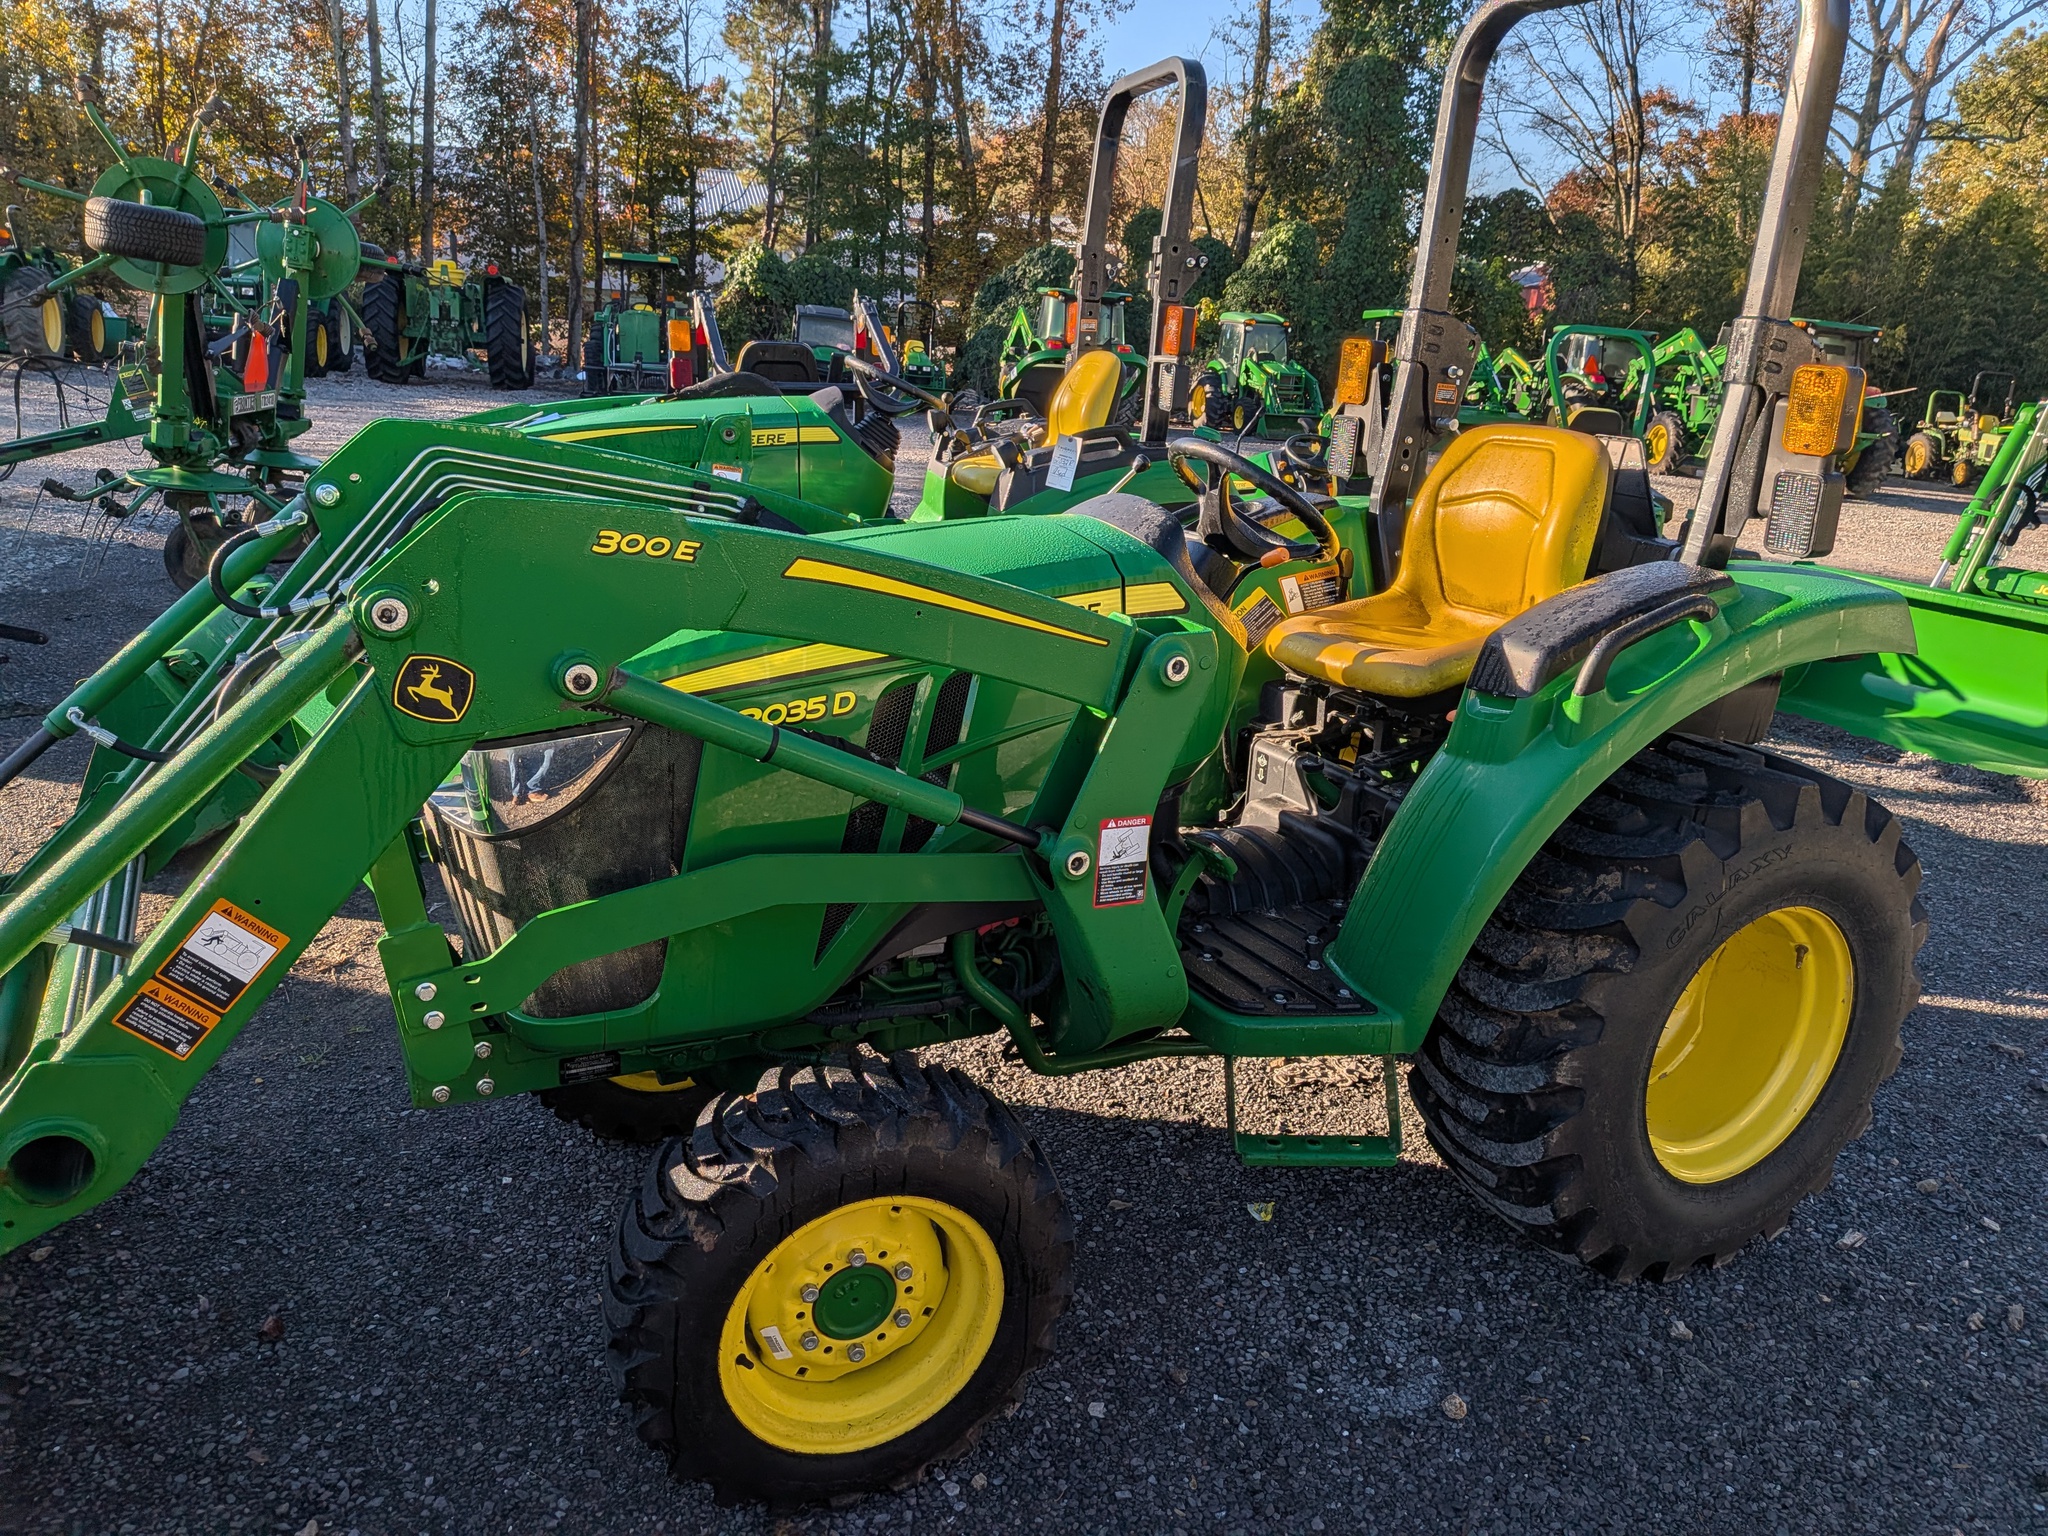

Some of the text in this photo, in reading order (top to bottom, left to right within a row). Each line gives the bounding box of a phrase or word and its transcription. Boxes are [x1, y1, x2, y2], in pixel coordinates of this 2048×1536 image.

[591, 529, 704, 563] 300 E
[1309, 569, 1337, 581] WARNING
[832, 691, 858, 717] D
[1117, 818, 1147, 827] DANGER
[1666, 843, 1792, 949] GALAXY
[234, 912, 279, 943] WARNING
[163, 993, 210, 1024] WARNING
